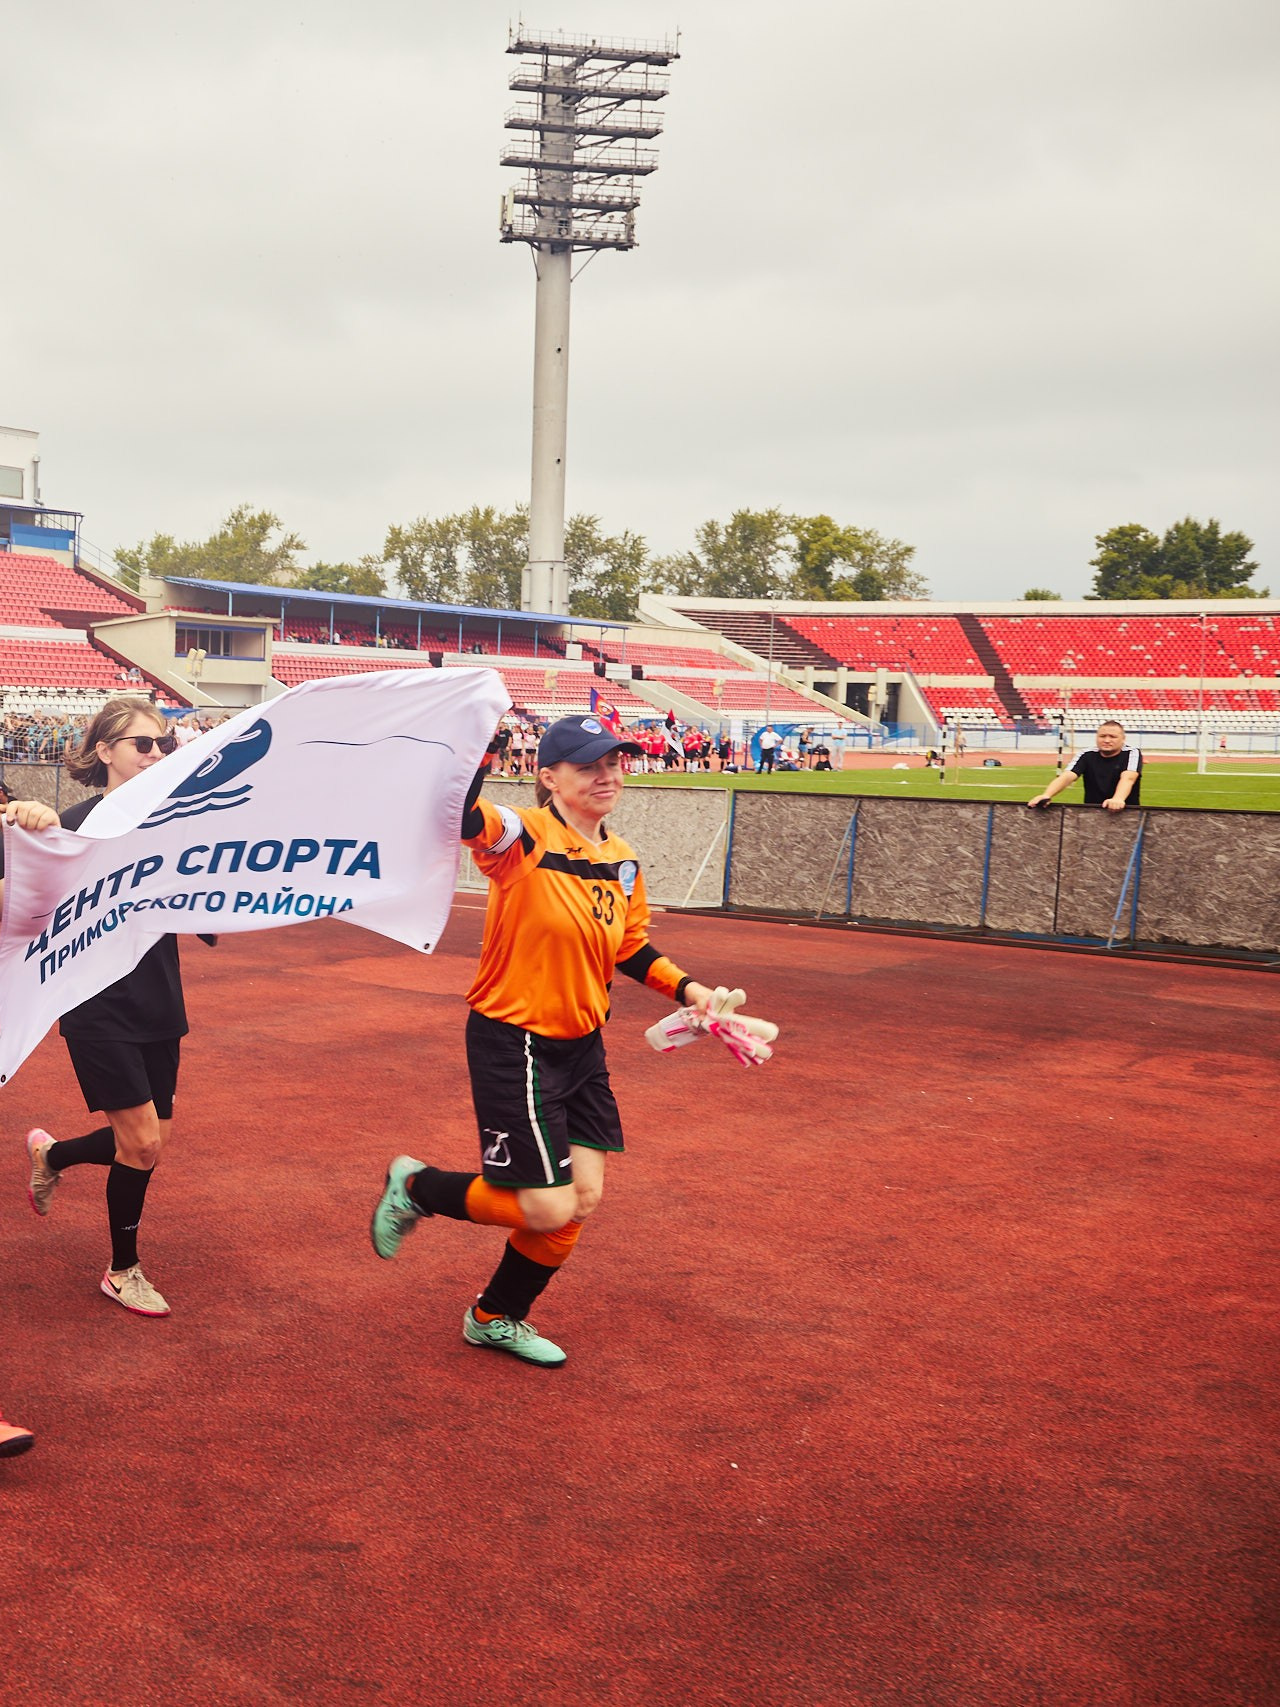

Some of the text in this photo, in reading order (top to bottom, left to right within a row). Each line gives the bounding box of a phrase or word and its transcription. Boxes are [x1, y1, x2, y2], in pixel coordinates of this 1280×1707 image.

[176, 838, 381, 879] СПОРТА
[592, 885, 615, 926] 33
[39, 891, 226, 985] ПРИМОРСКОГО
